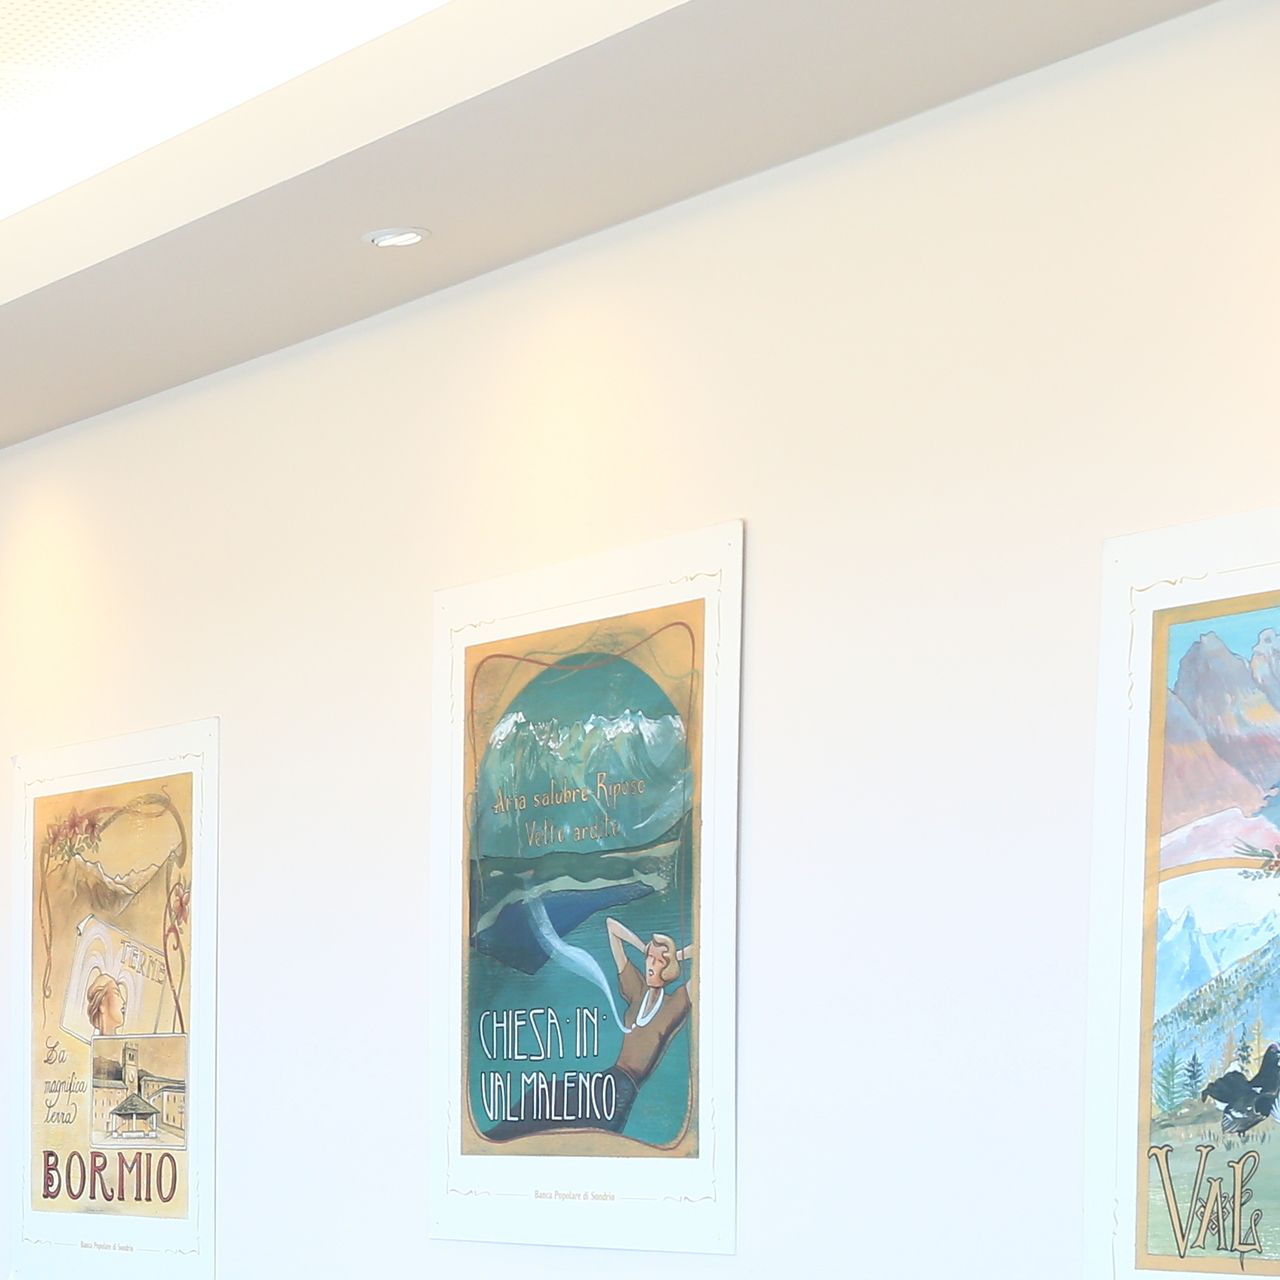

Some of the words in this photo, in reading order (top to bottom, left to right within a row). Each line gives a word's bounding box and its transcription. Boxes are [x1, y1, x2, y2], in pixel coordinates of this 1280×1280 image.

[493, 787, 527, 814] Aria
[534, 777, 589, 808] salubre
[120, 939, 167, 985] TERME
[479, 1007, 564, 1061] CHIESA
[576, 1007, 599, 1059] IN
[43, 1071, 88, 1106] magnifica
[42, 1150, 178, 1202] BORMIO
[534, 1190, 553, 1199] Banca
[554, 1190, 582, 1202] Popolare
[591, 1191, 616, 1202] Sondrio
